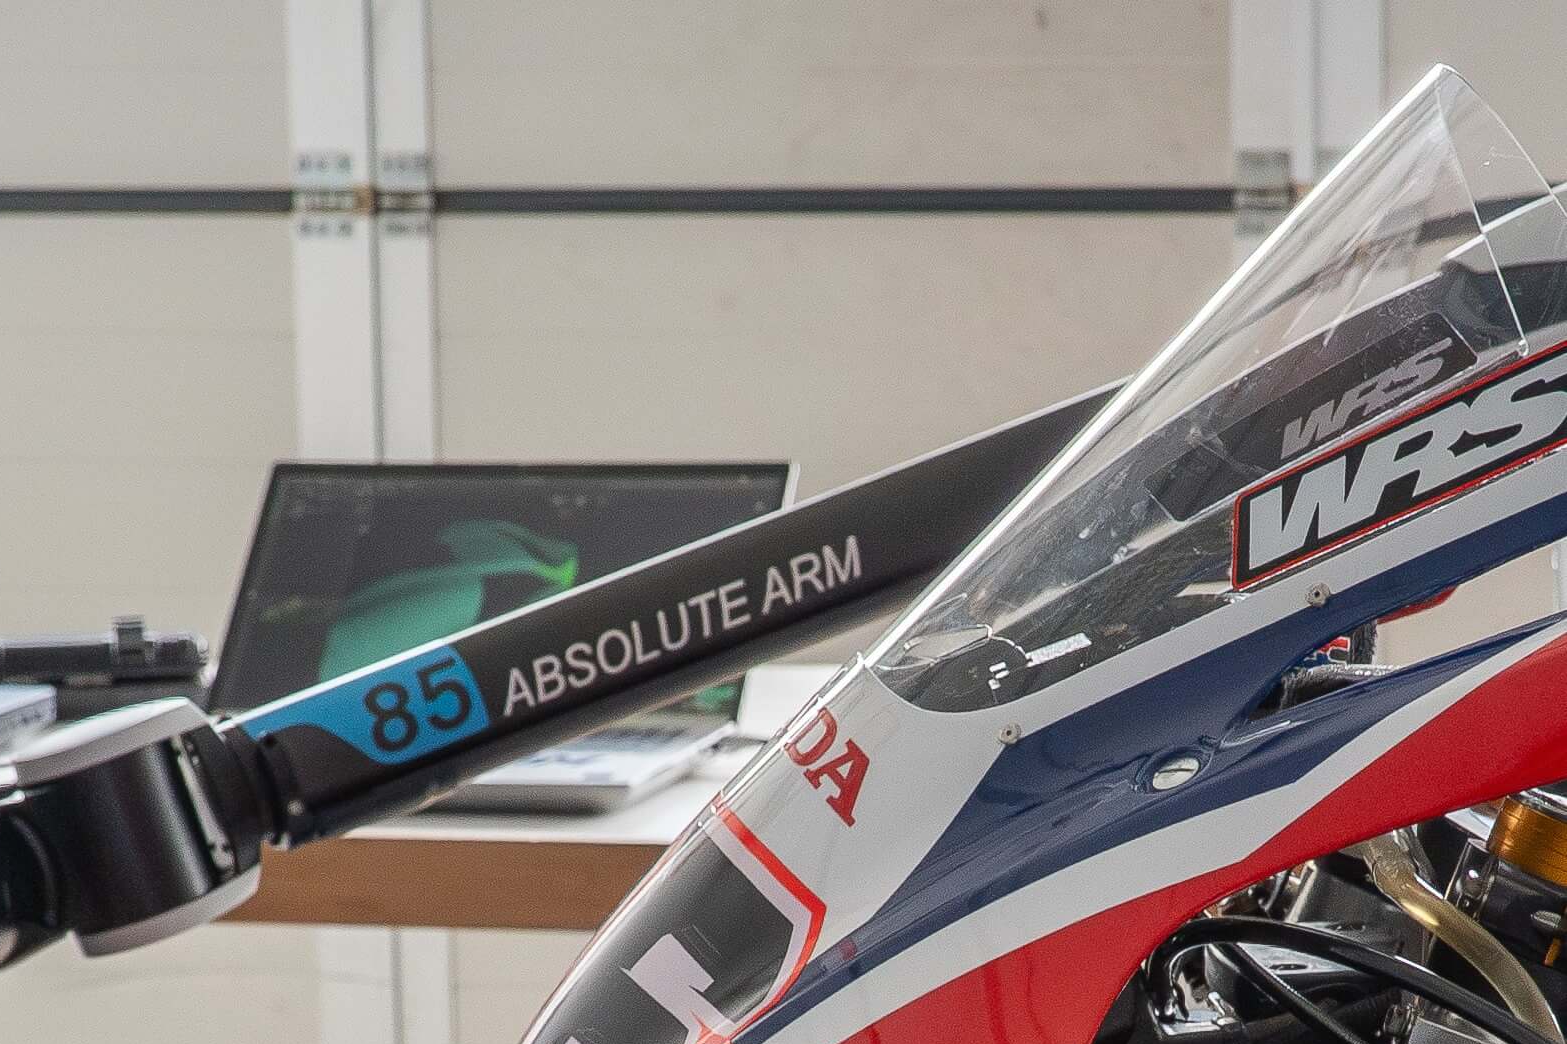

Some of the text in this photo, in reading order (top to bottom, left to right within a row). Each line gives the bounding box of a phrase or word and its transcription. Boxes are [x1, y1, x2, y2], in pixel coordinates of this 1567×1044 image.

[1248, 351, 1567, 571] WRS
[363, 535, 864, 753] 85 ABSOLUTE ARM
